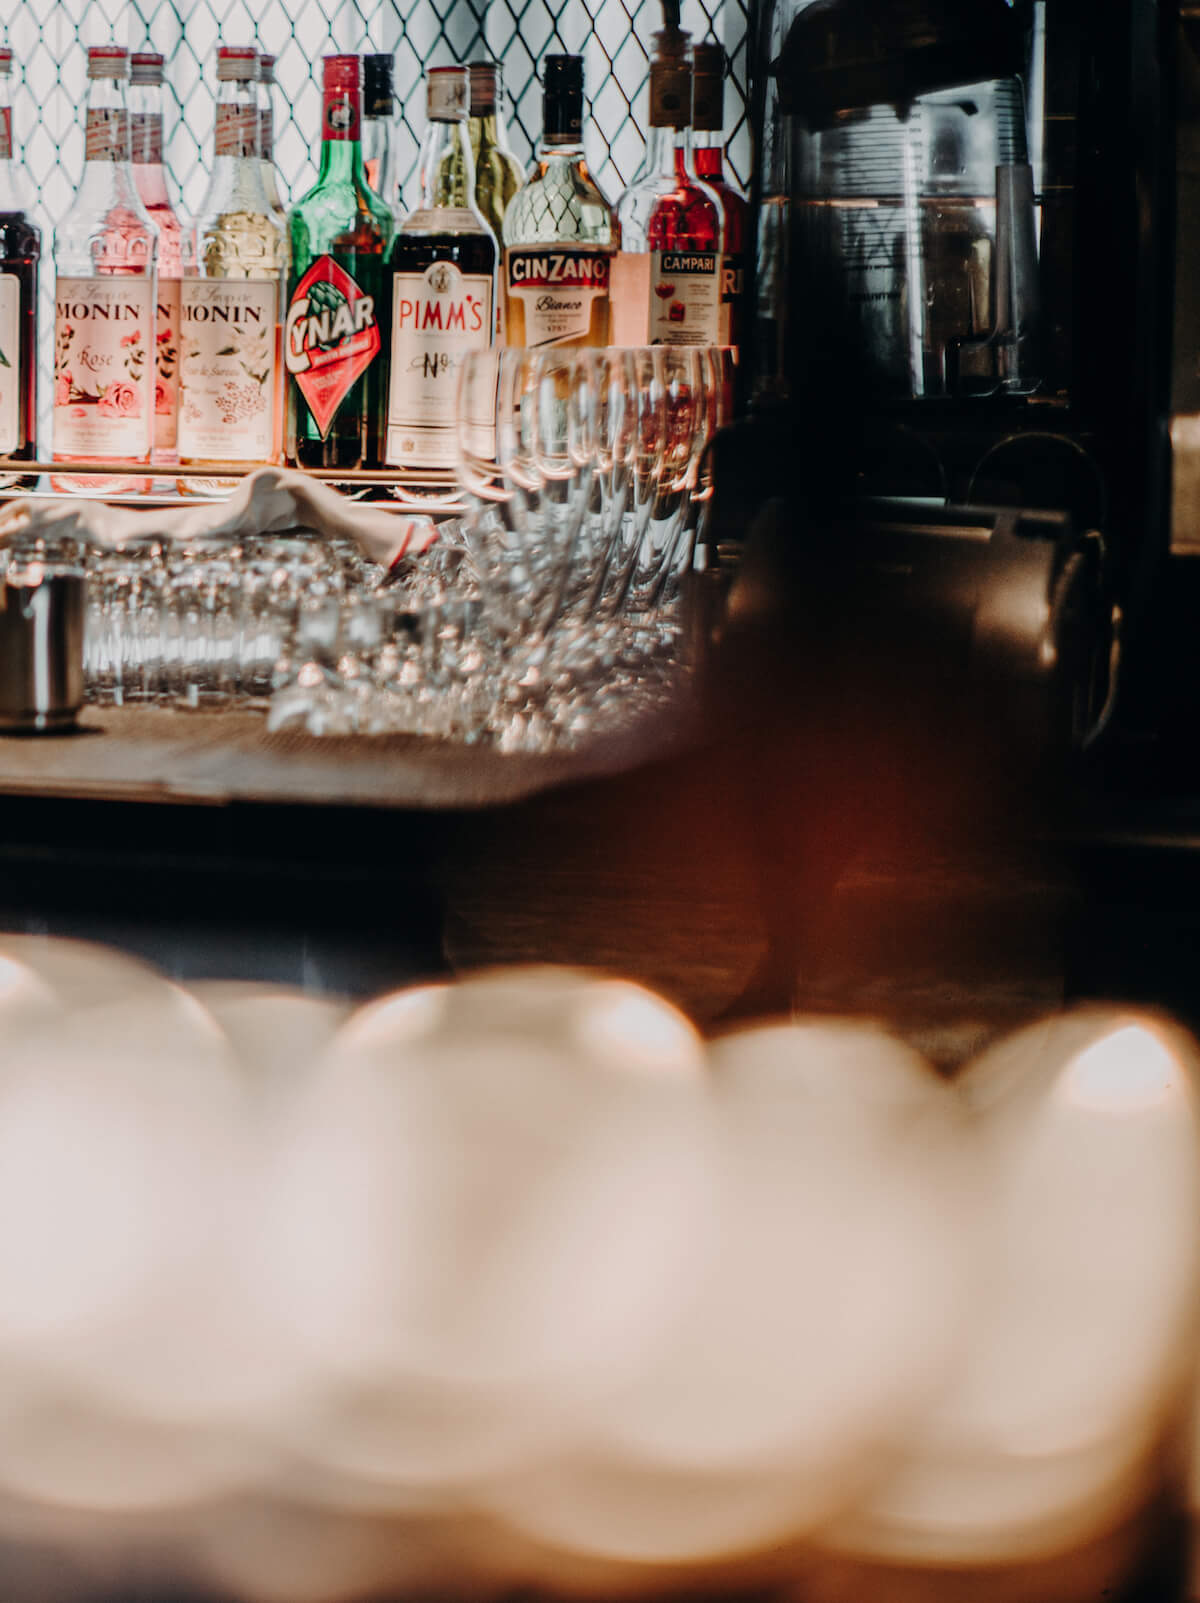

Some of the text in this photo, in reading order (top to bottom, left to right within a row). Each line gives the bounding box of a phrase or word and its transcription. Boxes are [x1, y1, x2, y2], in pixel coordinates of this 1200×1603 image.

[512, 253, 605, 281] CINZANO
[663, 254, 713, 270] CAMPARI
[56, 303, 140, 320] MONIN
[182, 304, 262, 323] MONIN
[400, 294, 484, 331] PIMM'S
[536, 295, 582, 312] Bianco
[285, 295, 375, 374] CYNAR
[77, 344, 114, 373] Rose
